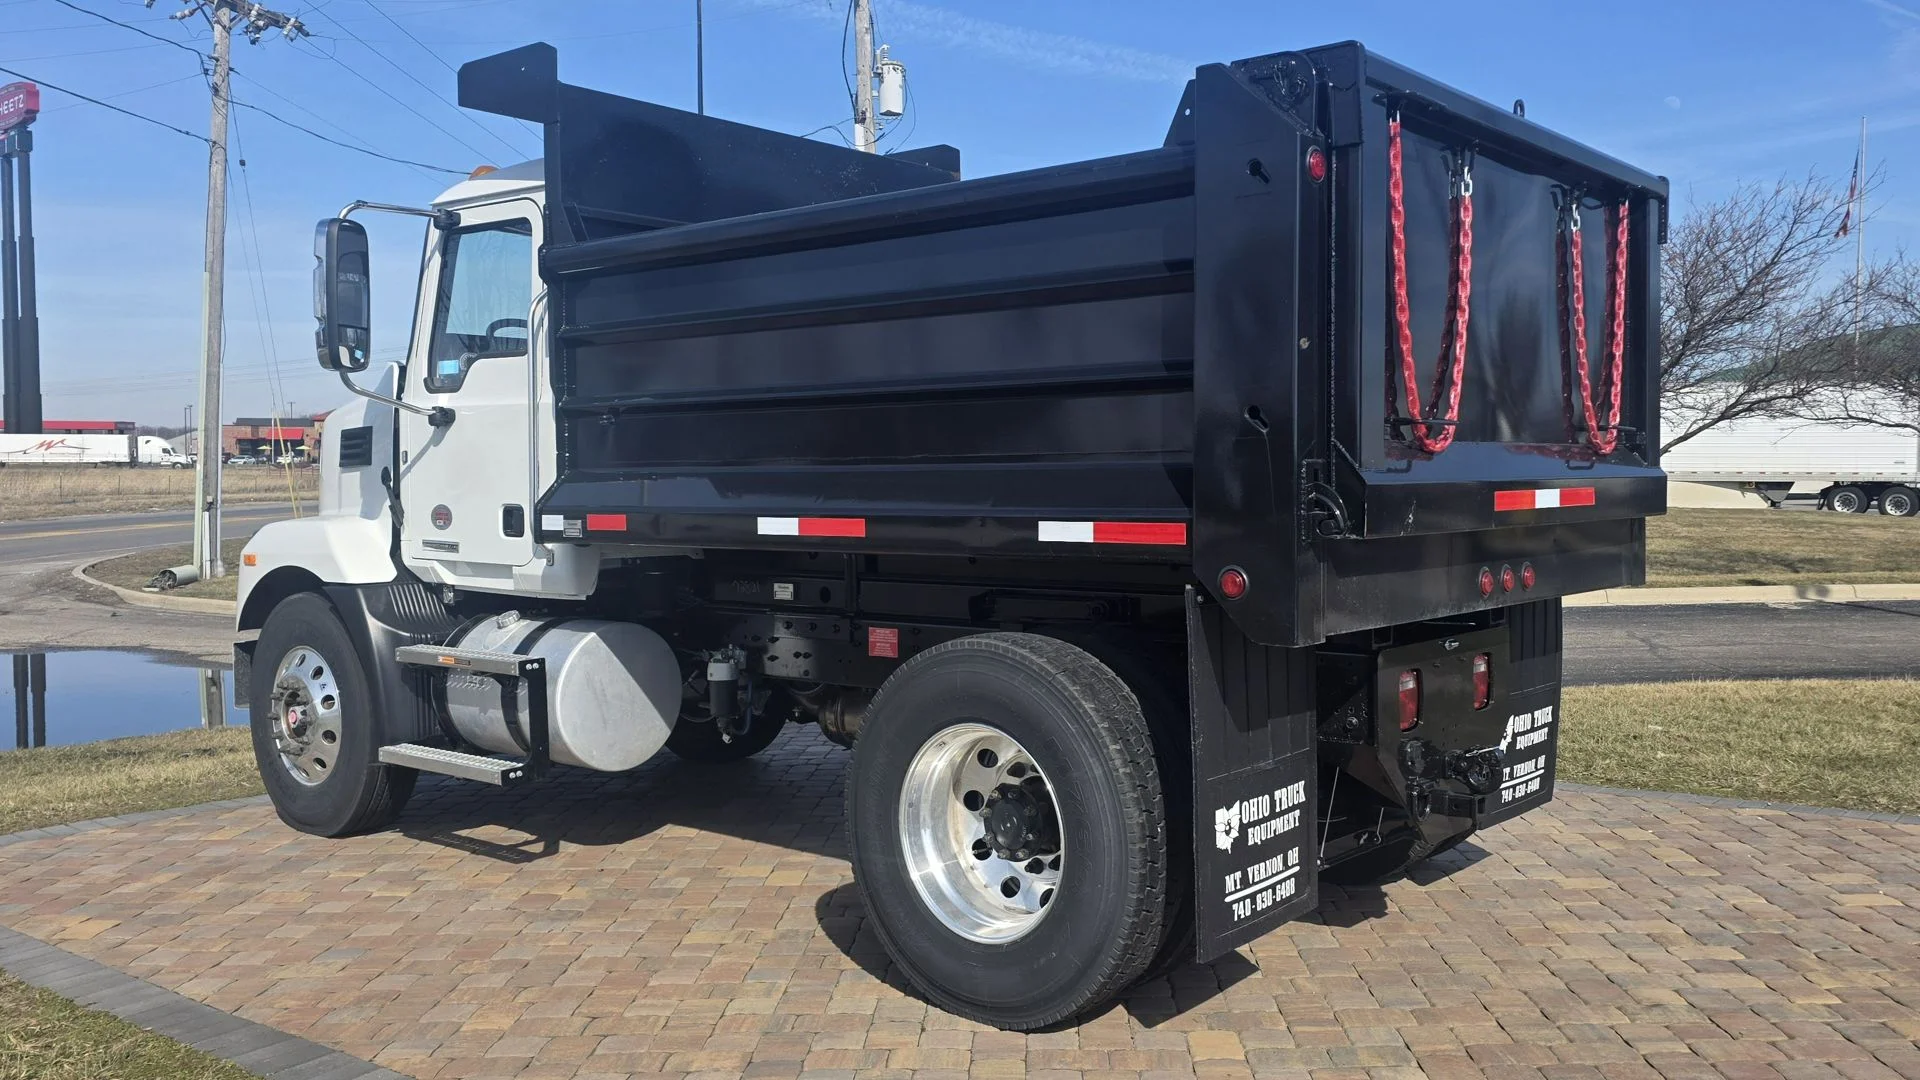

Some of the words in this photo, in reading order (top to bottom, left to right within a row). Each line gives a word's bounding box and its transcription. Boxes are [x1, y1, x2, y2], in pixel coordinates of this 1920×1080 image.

[1514, 712, 1532, 734] OHIO
[1534, 705, 1553, 727] TRUCK
[1516, 726, 1549, 750] EQUIPMENT
[1241, 794, 1270, 824] OHIO
[1274, 780, 1306, 813] TRUCK
[1247, 809, 1300, 846] EQUIPMENT
[1287, 846, 1299, 867] OH
[1232, 877, 1296, 922] 740-830-6488
